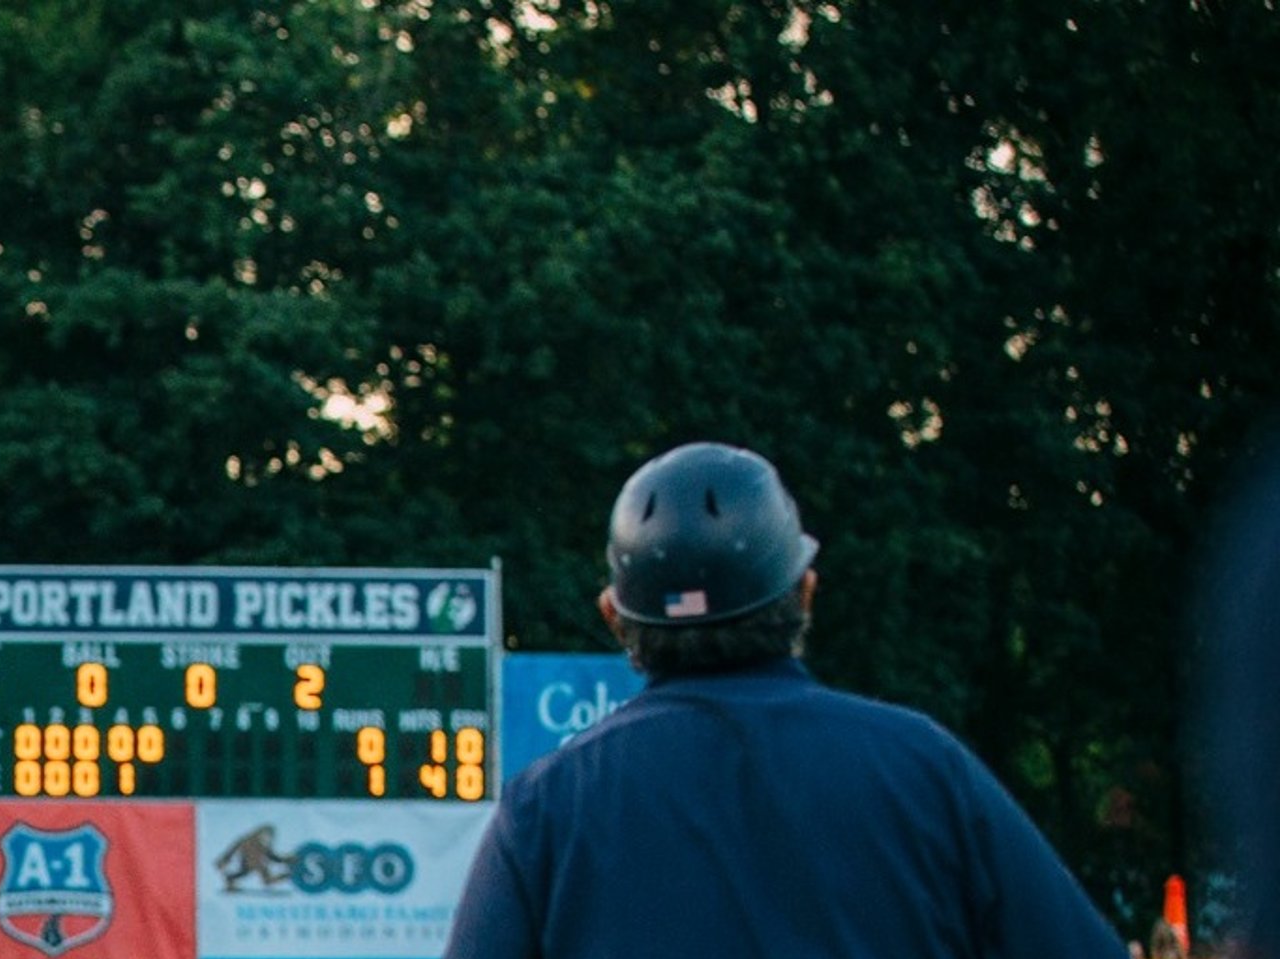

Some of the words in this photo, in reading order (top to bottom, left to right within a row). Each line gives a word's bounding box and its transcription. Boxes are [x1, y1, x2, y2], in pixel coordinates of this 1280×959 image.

[234, 582, 420, 630] PICKLES
[62, 642, 121, 667] BALL
[161, 643, 239, 669] STRIKE
[284, 645, 331, 669] OUT
[76, 662, 108, 707] 0
[185, 663, 216, 708] 0
[294, 665, 325, 711] 2
[333, 709, 384, 731] RUNS
[398, 711, 442, 733] HITS
[17, 842, 91, 887] A-1
[302, 850, 407, 888] SFO
